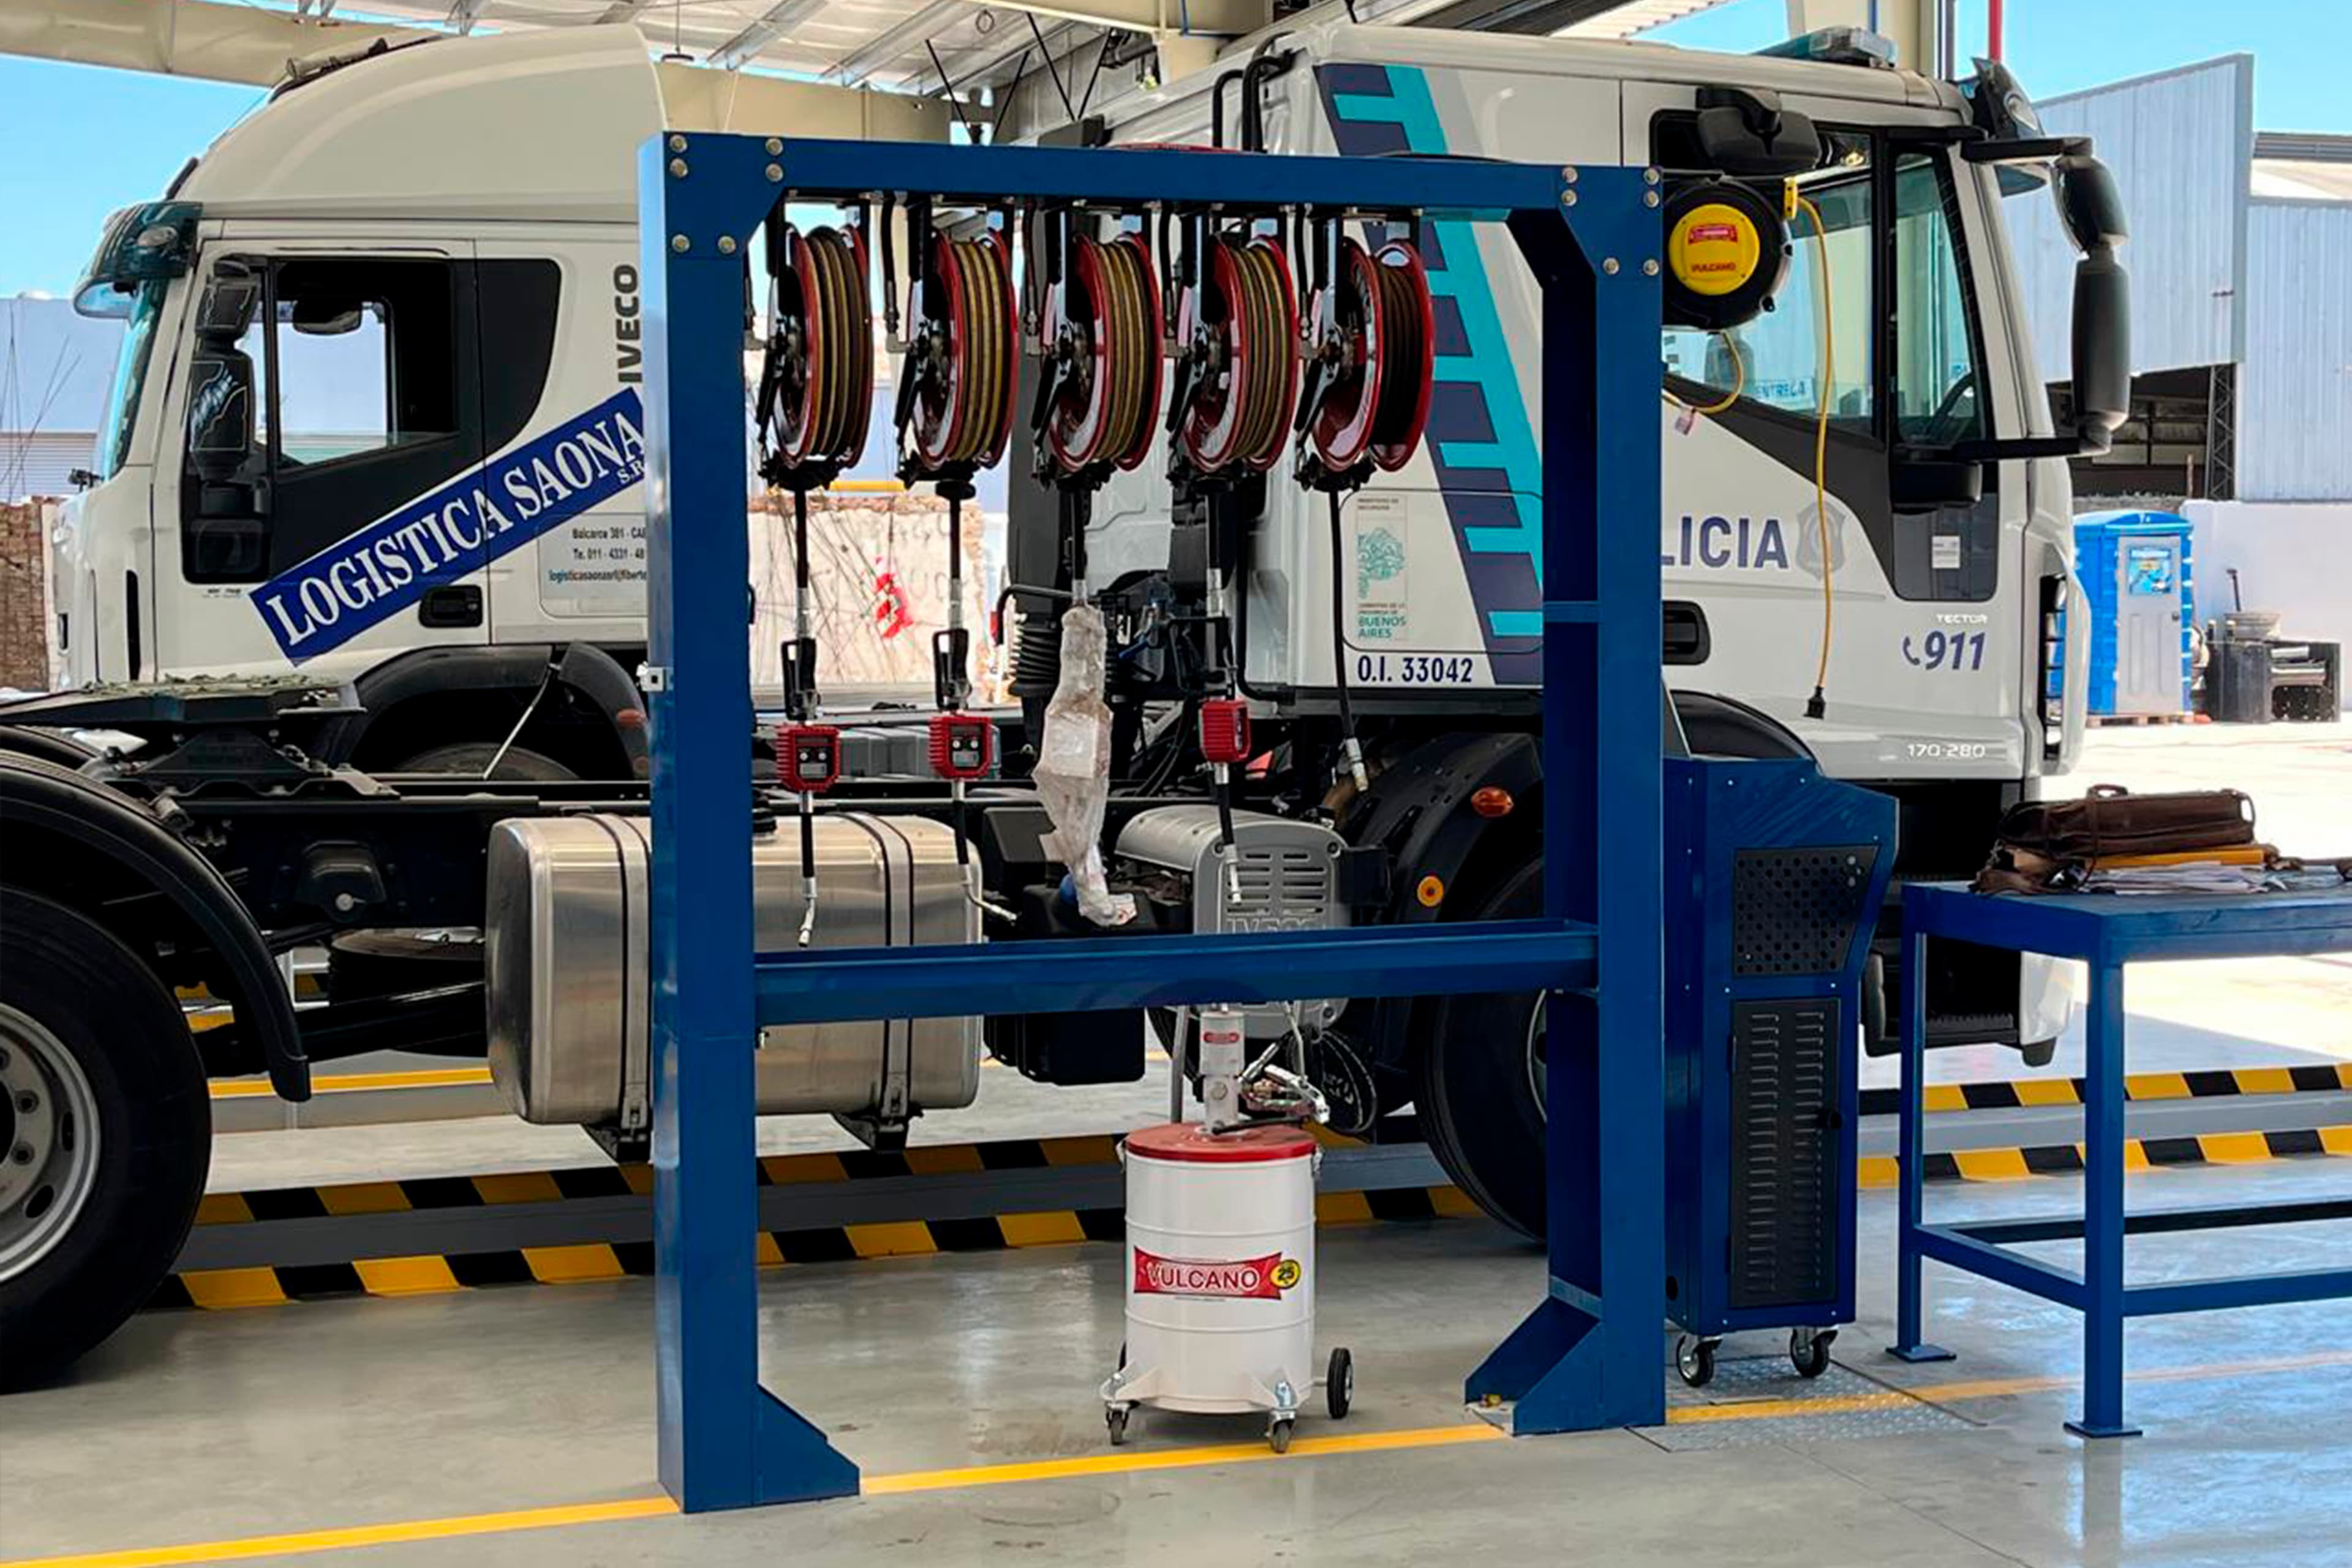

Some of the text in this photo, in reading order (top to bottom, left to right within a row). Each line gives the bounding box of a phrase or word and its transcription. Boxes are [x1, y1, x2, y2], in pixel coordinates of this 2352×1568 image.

[614, 264, 642, 382] IVECO
[266, 412, 644, 647] LOGISTICA SAONA
[1358, 616, 1407, 627] BUENOS
[1358, 627, 1392, 638] AIRES
[1936, 614, 1988, 624] TECTOR
[1924, 630, 1985, 670] 911
[1402, 657, 1473, 682] 33042
[1146, 1261, 1258, 1291] VULCANO
